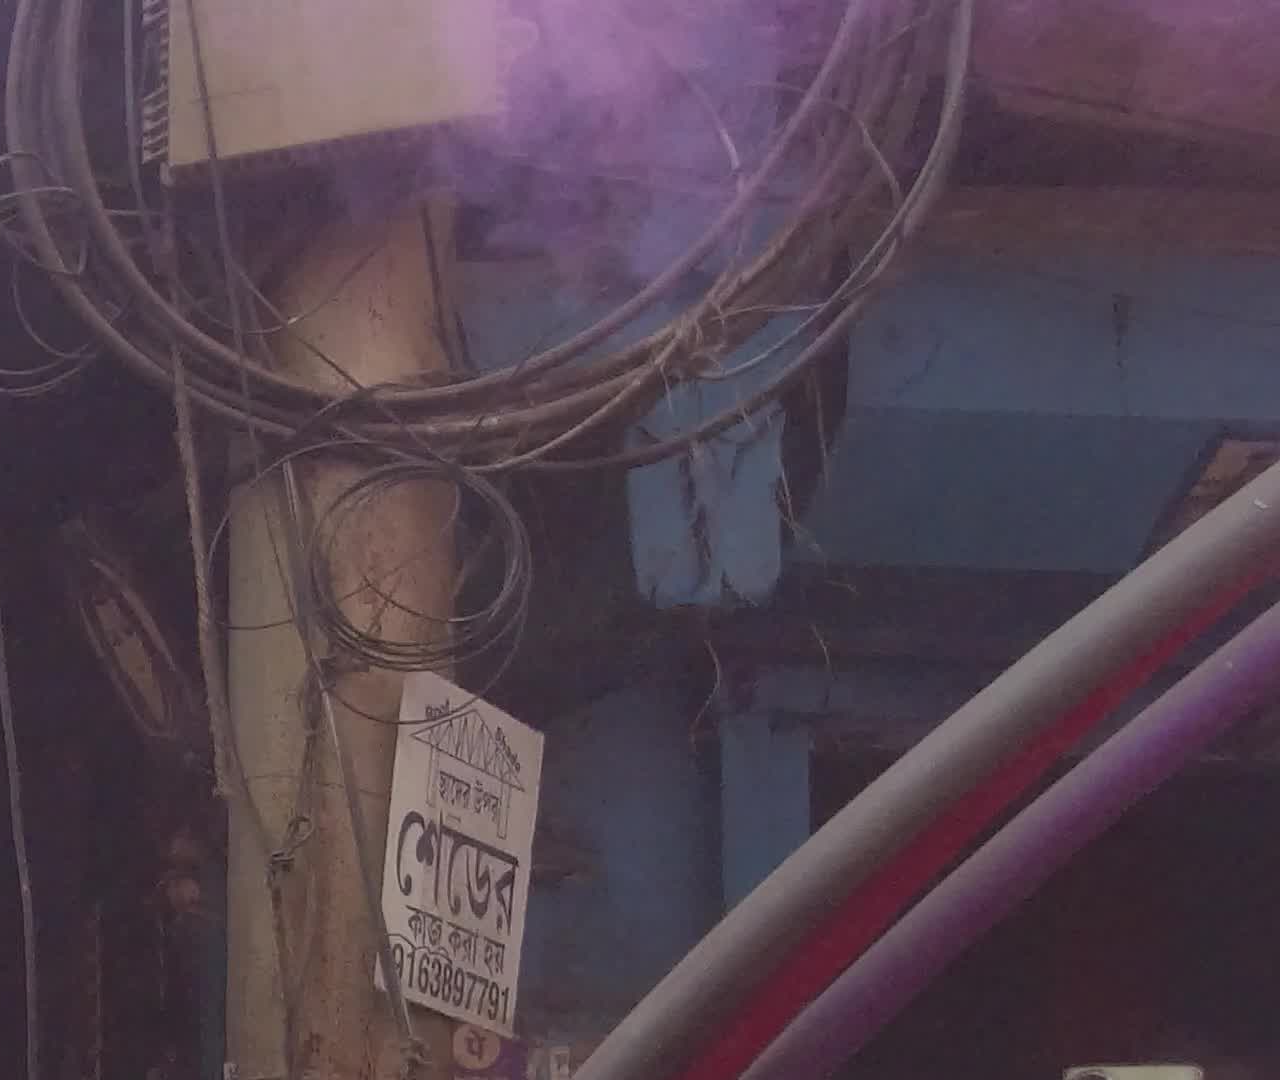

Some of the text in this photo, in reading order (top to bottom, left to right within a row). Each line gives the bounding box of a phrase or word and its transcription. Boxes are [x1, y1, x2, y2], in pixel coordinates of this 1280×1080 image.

[396, 810, 519, 937] শেডের
[406, 905, 443, 947] কাজ
[447, 921, 479, 965] করা
[391, 943, 510, 1025] 9163897791
